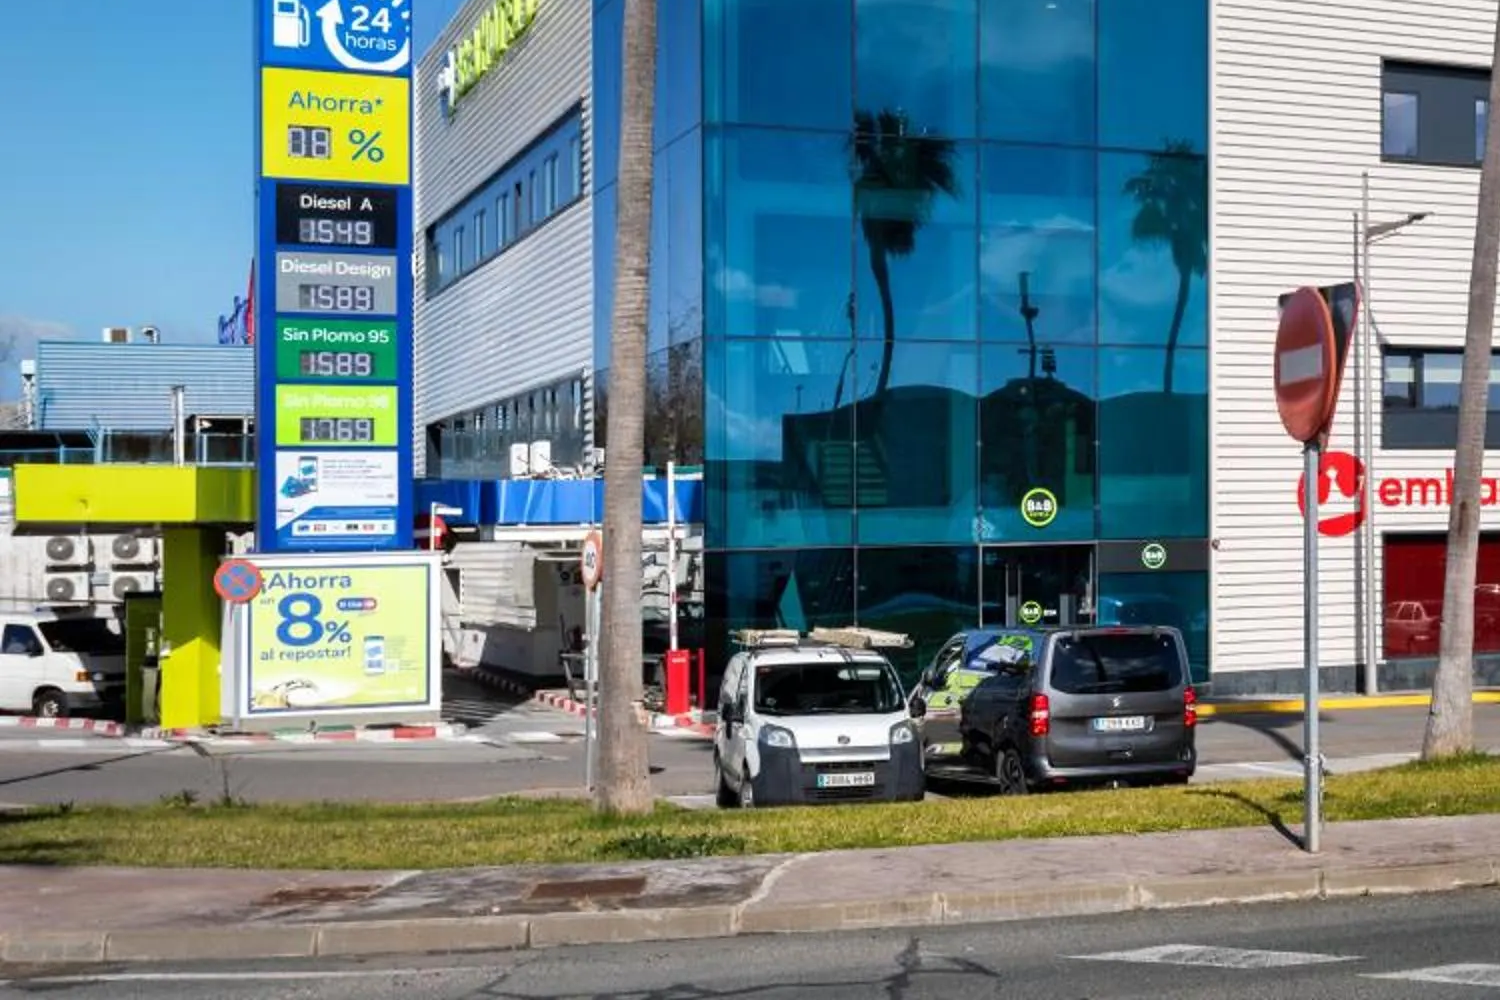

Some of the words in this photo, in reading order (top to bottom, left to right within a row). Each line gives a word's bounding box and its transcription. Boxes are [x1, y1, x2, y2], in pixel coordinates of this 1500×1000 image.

[350, 5, 393, 34] 24
[345, 32, 397, 52] horas
[299, 194, 351, 210] Diesel
[360, 197, 373, 211] A
[281, 259, 333, 275] Diesel
[335, 261, 392, 279] Design
[283, 328, 309, 341] Sin
[312, 328, 365, 343] Plomo
[367, 330, 390, 343] 95
[260, 647, 274, 661] al
[279, 646, 352, 664] repostar!
